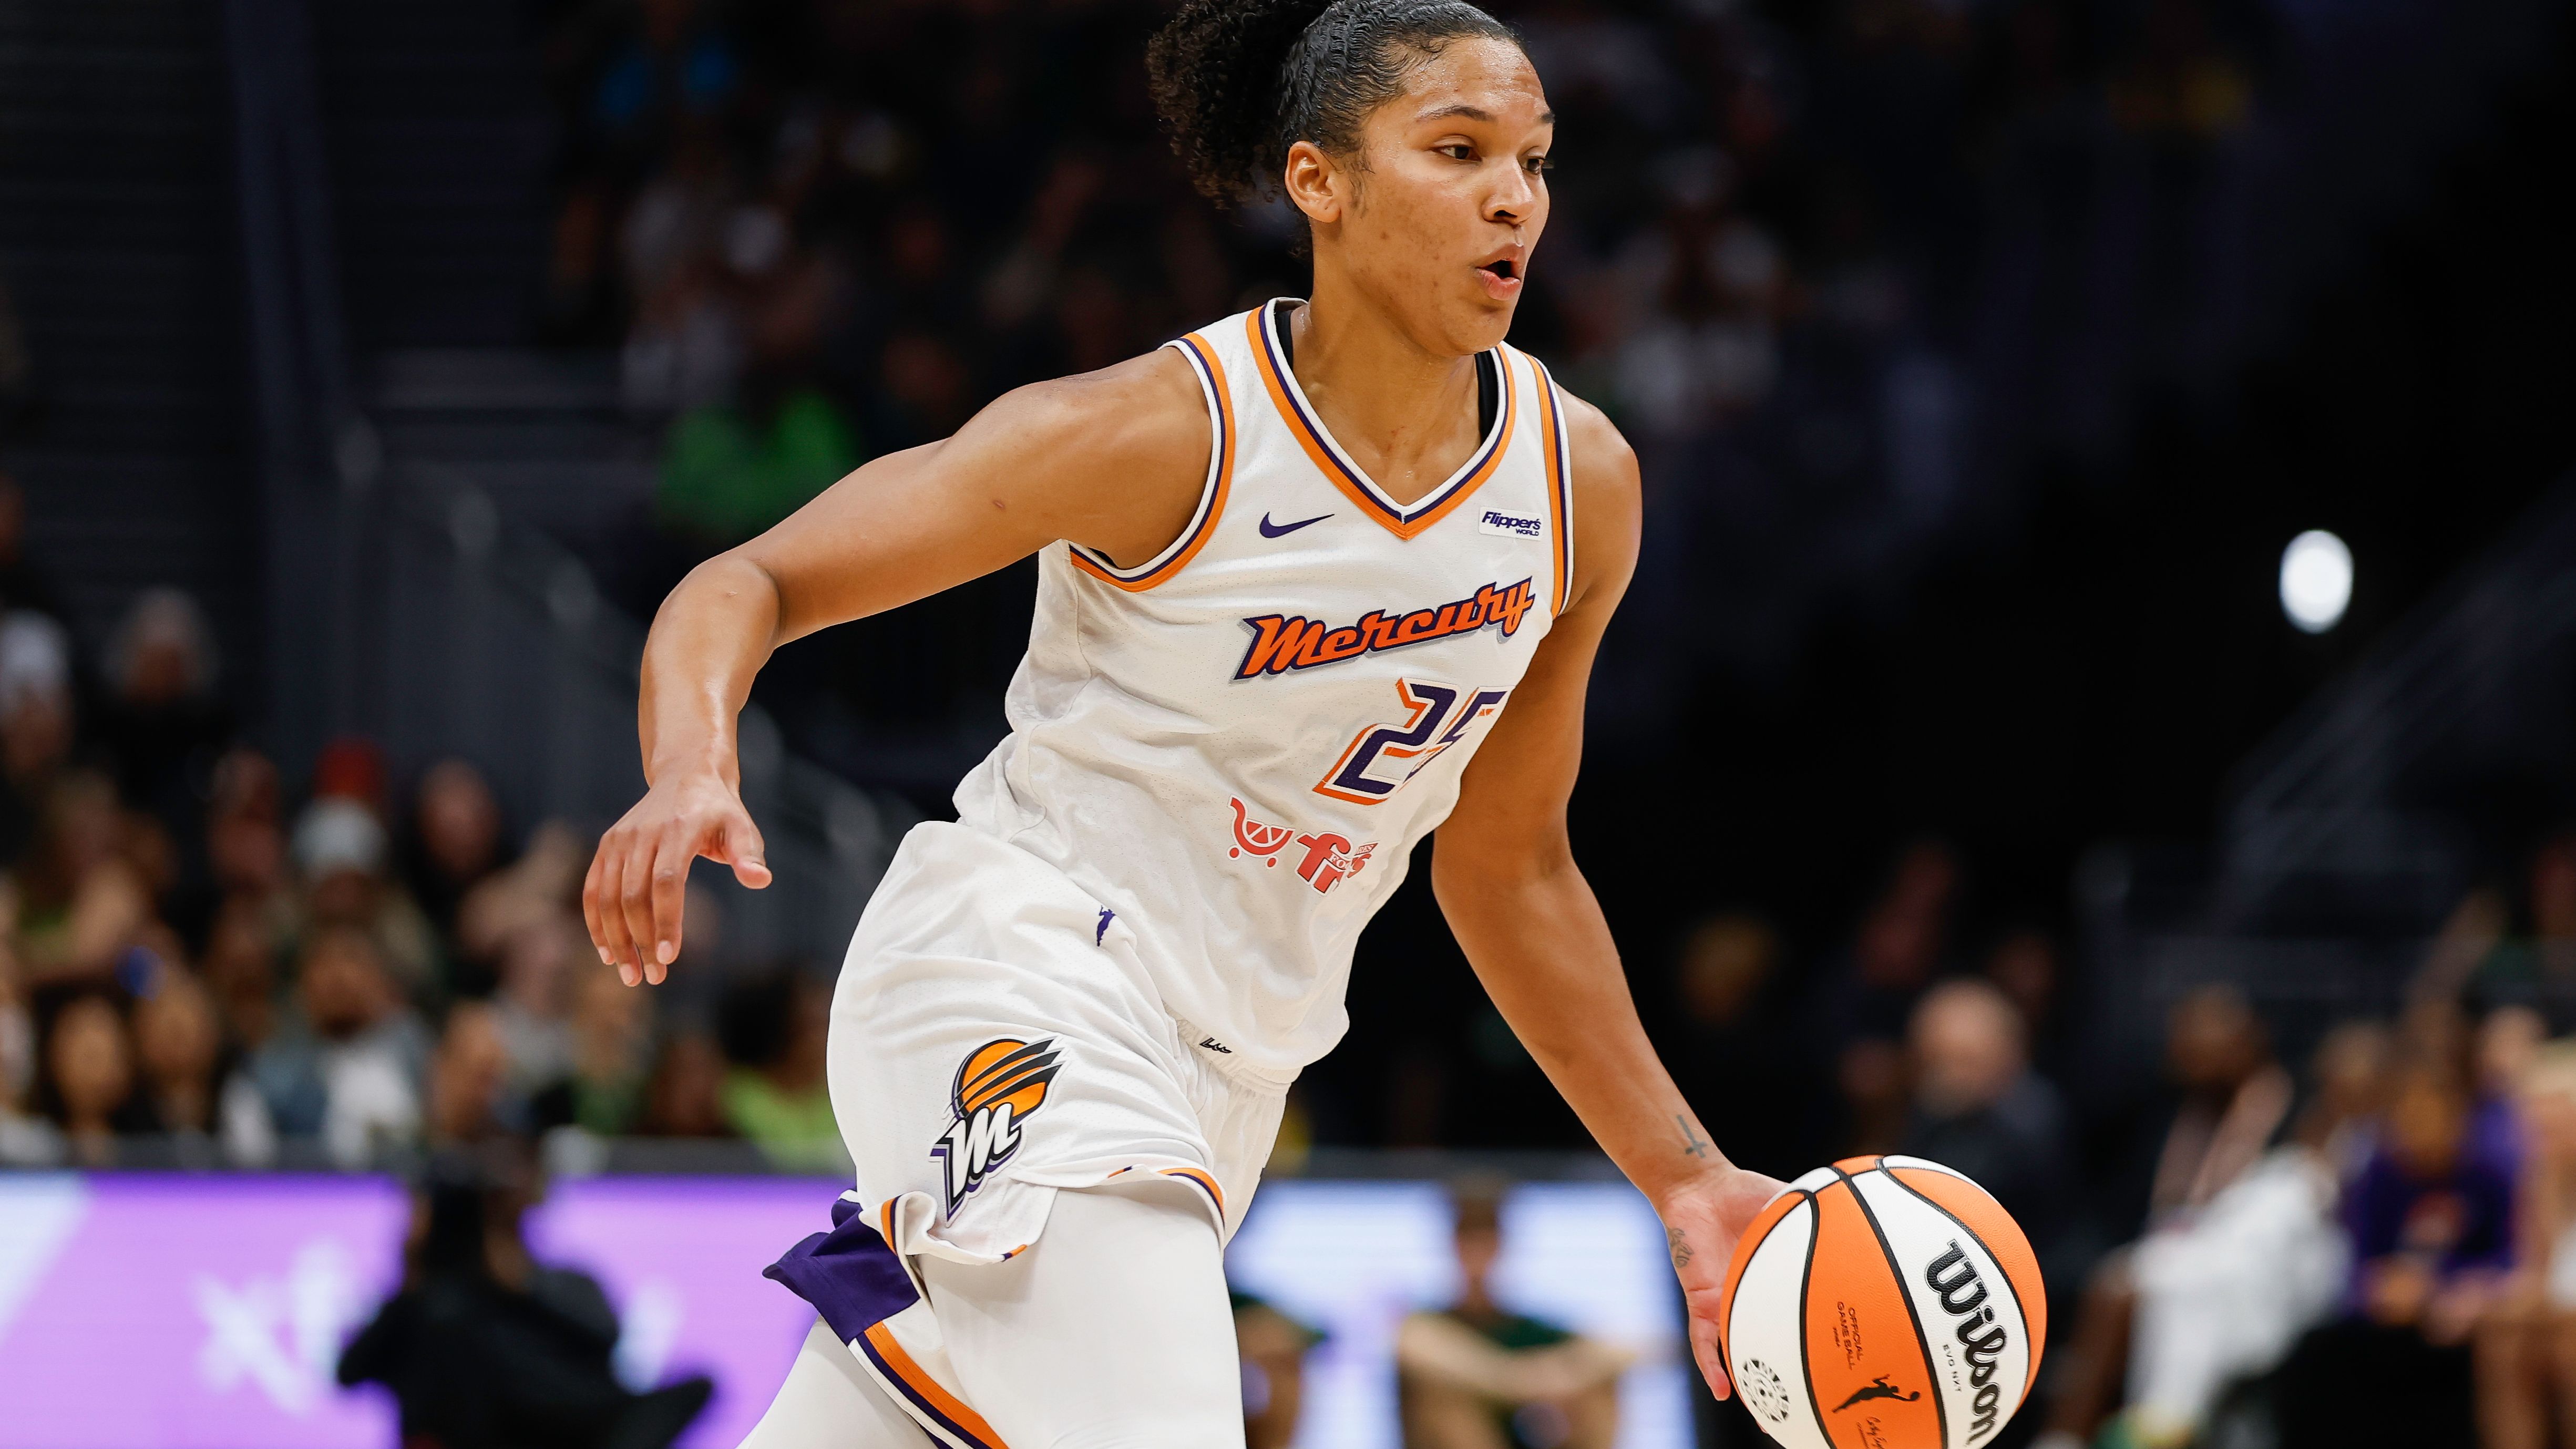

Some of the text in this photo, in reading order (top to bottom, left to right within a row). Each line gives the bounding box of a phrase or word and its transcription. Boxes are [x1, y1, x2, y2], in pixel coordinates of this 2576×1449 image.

[1234, 576, 1535, 680] Mercury
[1837, 1301, 1855, 1371] GAME BALL
[1848, 1307, 1864, 1361] OFFICIAL
[1925, 1238, 2006, 1447] Wilson
[1942, 1344, 1955, 1366] EVO
